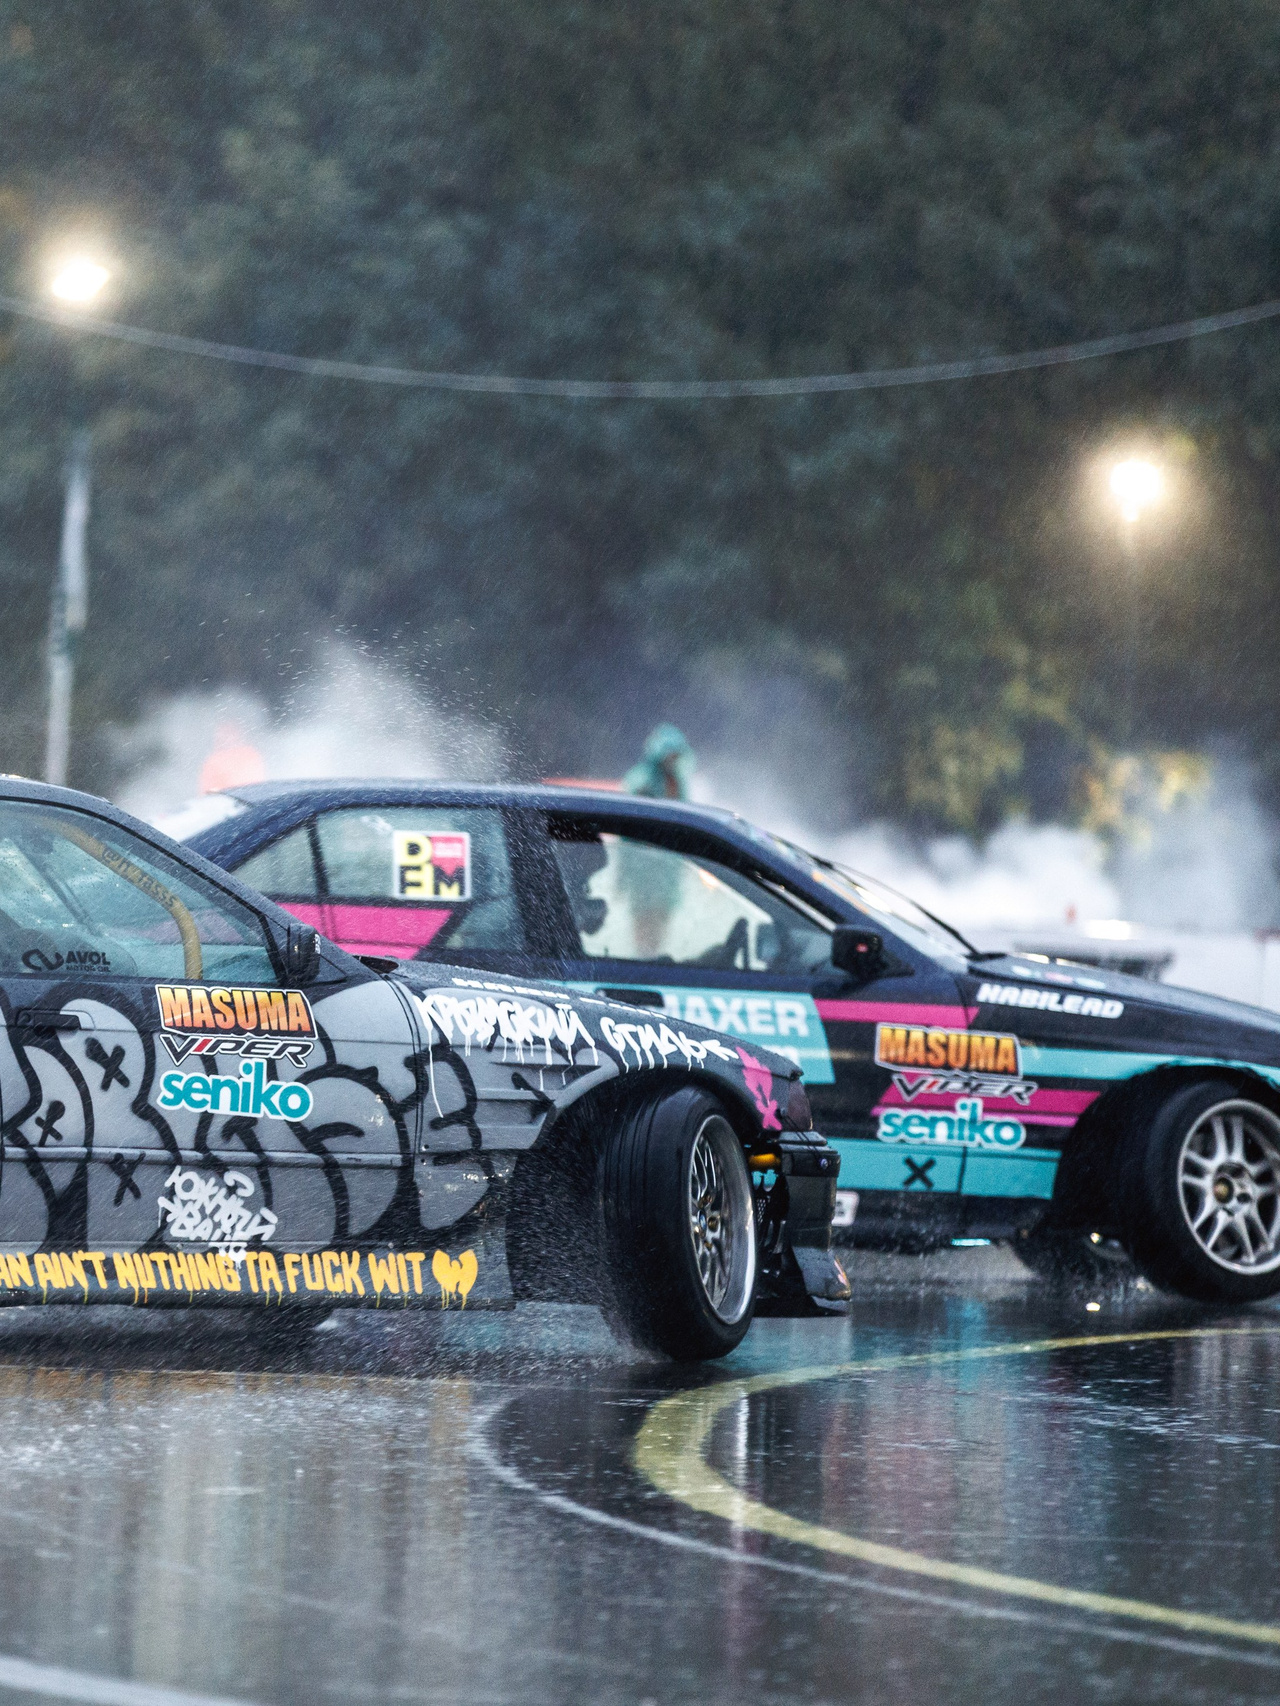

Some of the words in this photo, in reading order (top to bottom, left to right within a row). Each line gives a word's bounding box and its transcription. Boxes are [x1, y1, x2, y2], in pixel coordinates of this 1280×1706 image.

[66, 951, 111, 965] AVOL
[158, 986, 312, 1032] MASUMA
[160, 1035, 314, 1068] VIPER
[879, 1027, 1017, 1073] MASUMA
[160, 1061, 311, 1119] seniko
[892, 1074, 1038, 1105] VIPER
[882, 1102, 1022, 1146] seniko
[245, 1251, 283, 1293] TA
[284, 1250, 366, 1296] FUCK
[368, 1252, 425, 1295] WIT
